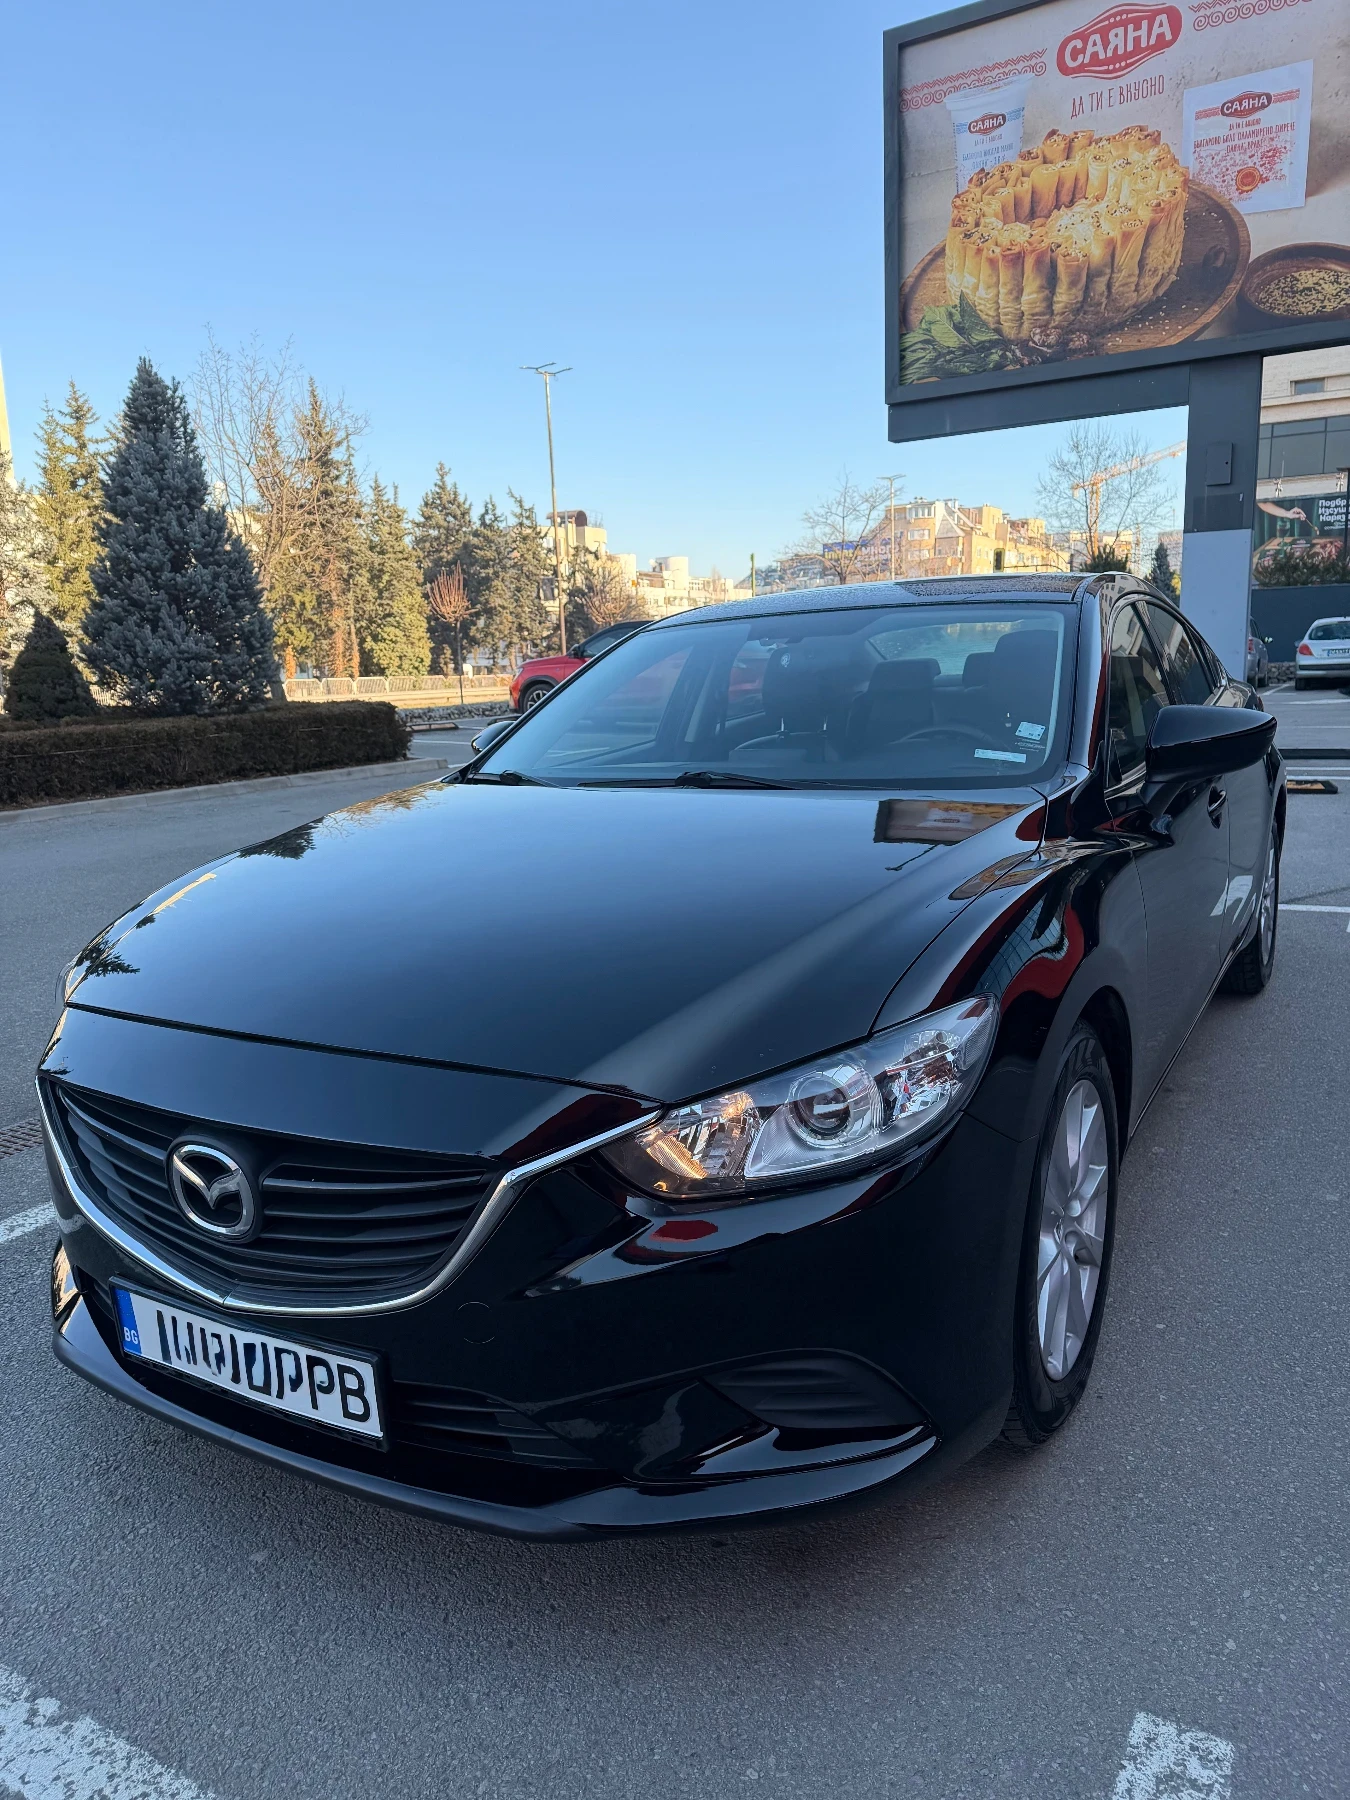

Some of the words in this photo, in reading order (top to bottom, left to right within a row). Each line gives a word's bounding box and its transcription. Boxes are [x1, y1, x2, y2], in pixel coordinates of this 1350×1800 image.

[1065, 13, 1173, 68] САЯНА
[1071, 96, 1085, 120] ДА
[1089, 90, 1103, 112] ТИ
[1108, 88, 1115, 108] Е
[1119, 75, 1165, 105] ВКУСНО
[1223, 95, 1268, 114] САЯНА
[970, 116, 1004, 132] САЯНА
[123, 1326, 139, 1345] BG
